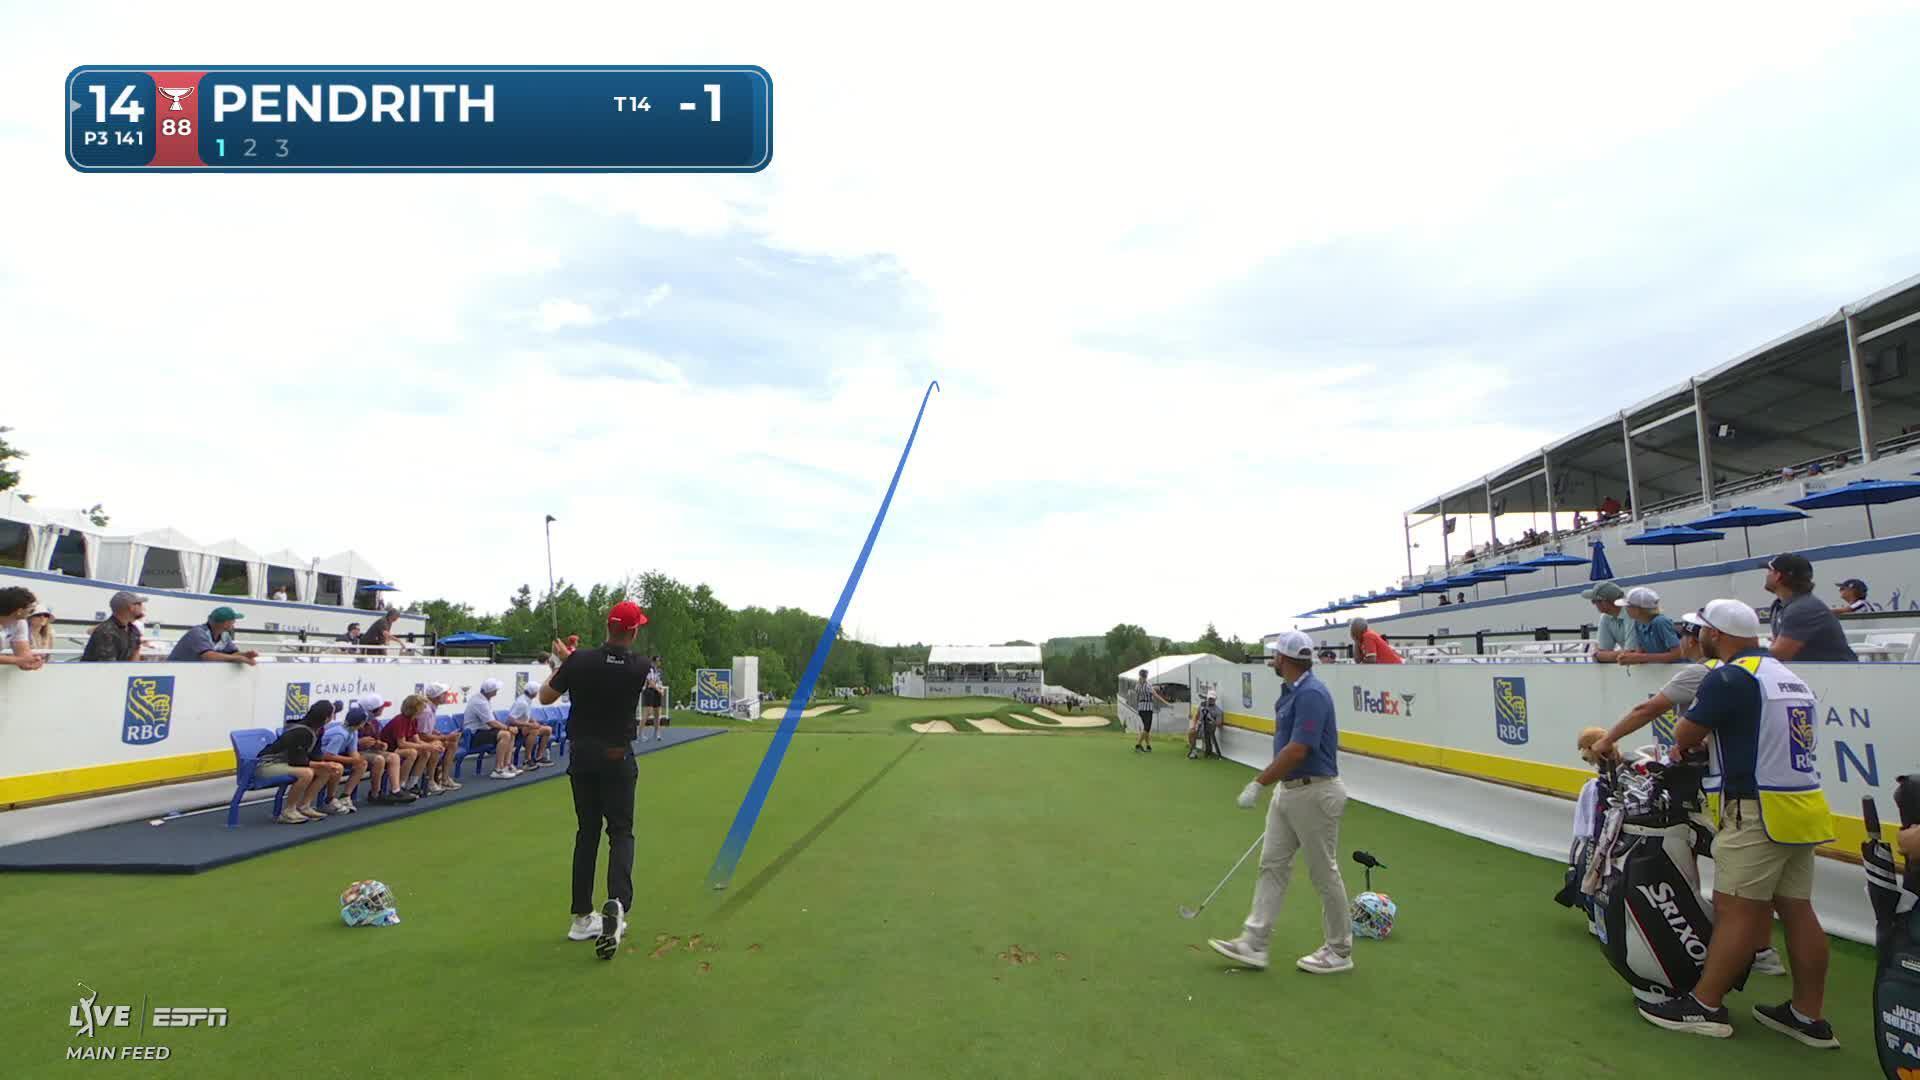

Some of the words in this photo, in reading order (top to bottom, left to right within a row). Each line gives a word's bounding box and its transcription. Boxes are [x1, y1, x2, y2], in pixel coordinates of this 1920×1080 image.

[315, 681, 376, 696] CANADIAN
[699, 699, 728, 710] RBC
[1364, 690, 1399, 716] FedEx
[126, 724, 167, 742] RBC
[1498, 723, 1526, 741] RBC
[1636, 882, 1708, 967] SRIXO
[1886, 1032, 1920, 1060] FA
